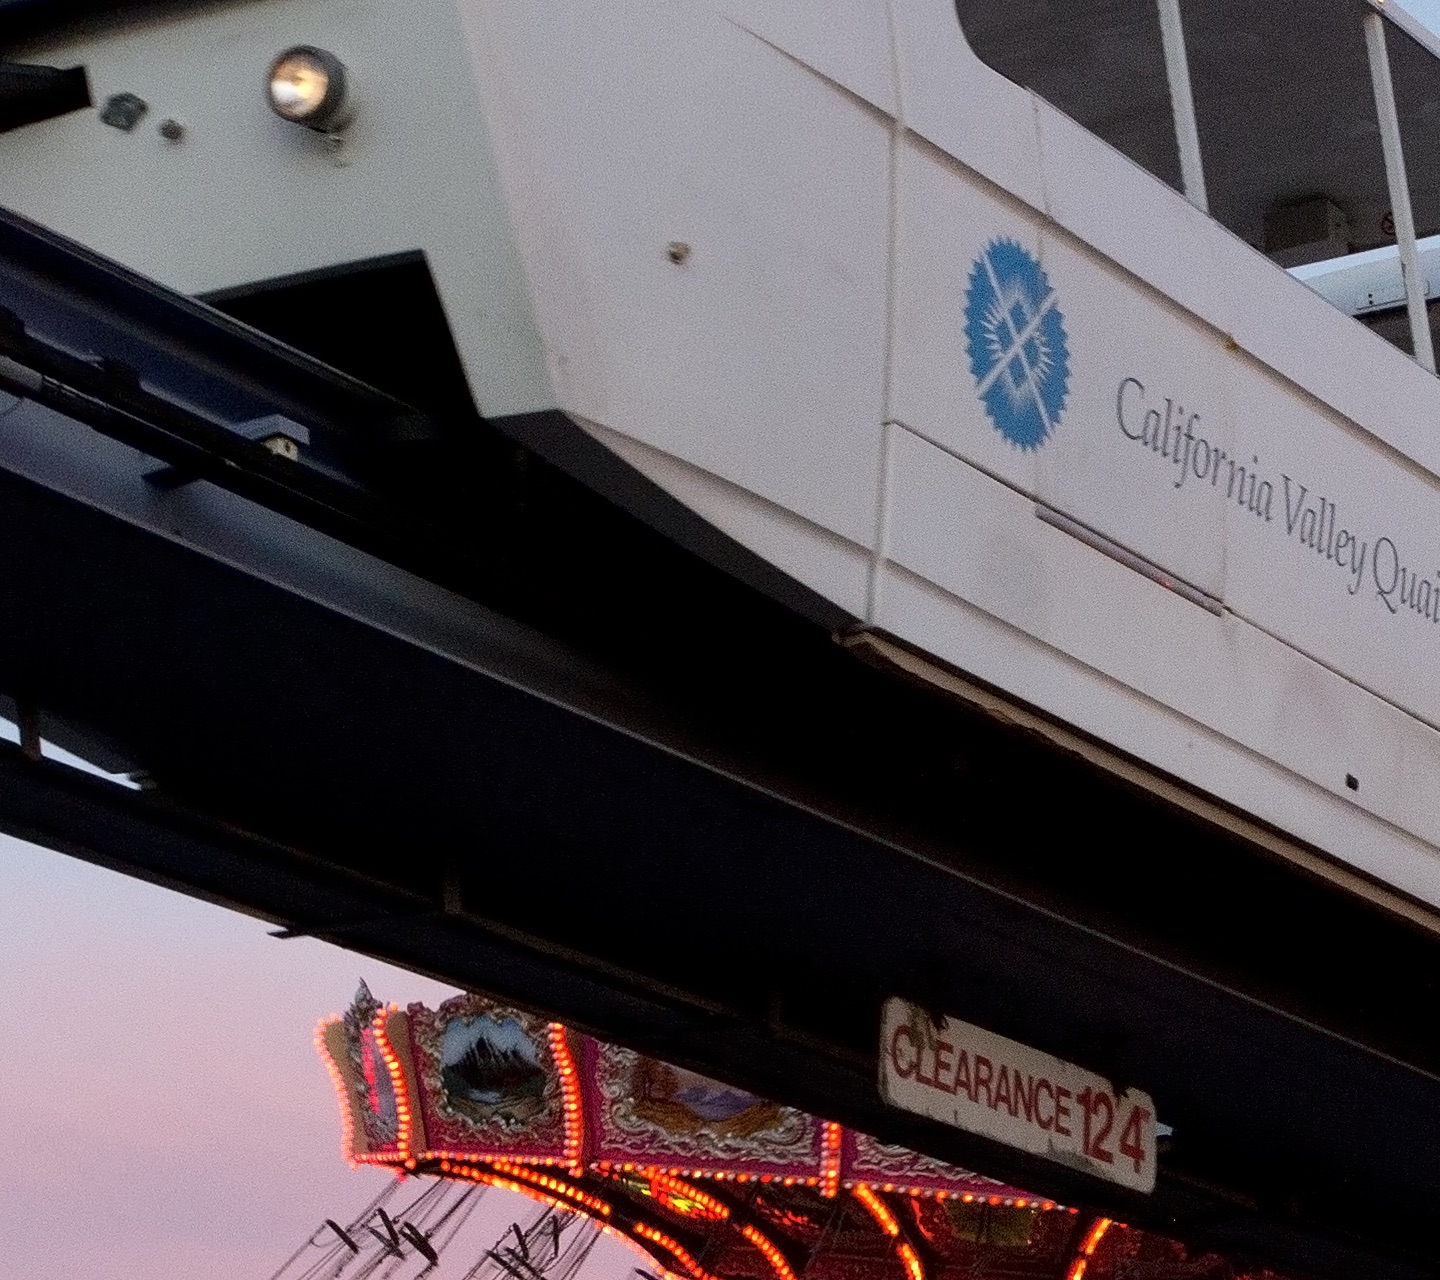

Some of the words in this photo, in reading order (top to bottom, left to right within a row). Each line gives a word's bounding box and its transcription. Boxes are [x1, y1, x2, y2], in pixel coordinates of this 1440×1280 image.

[1115, 377, 1274, 522] California
[1281, 474, 1367, 596] Valley
[890, 1024, 1073, 1137] CLEARANCE
